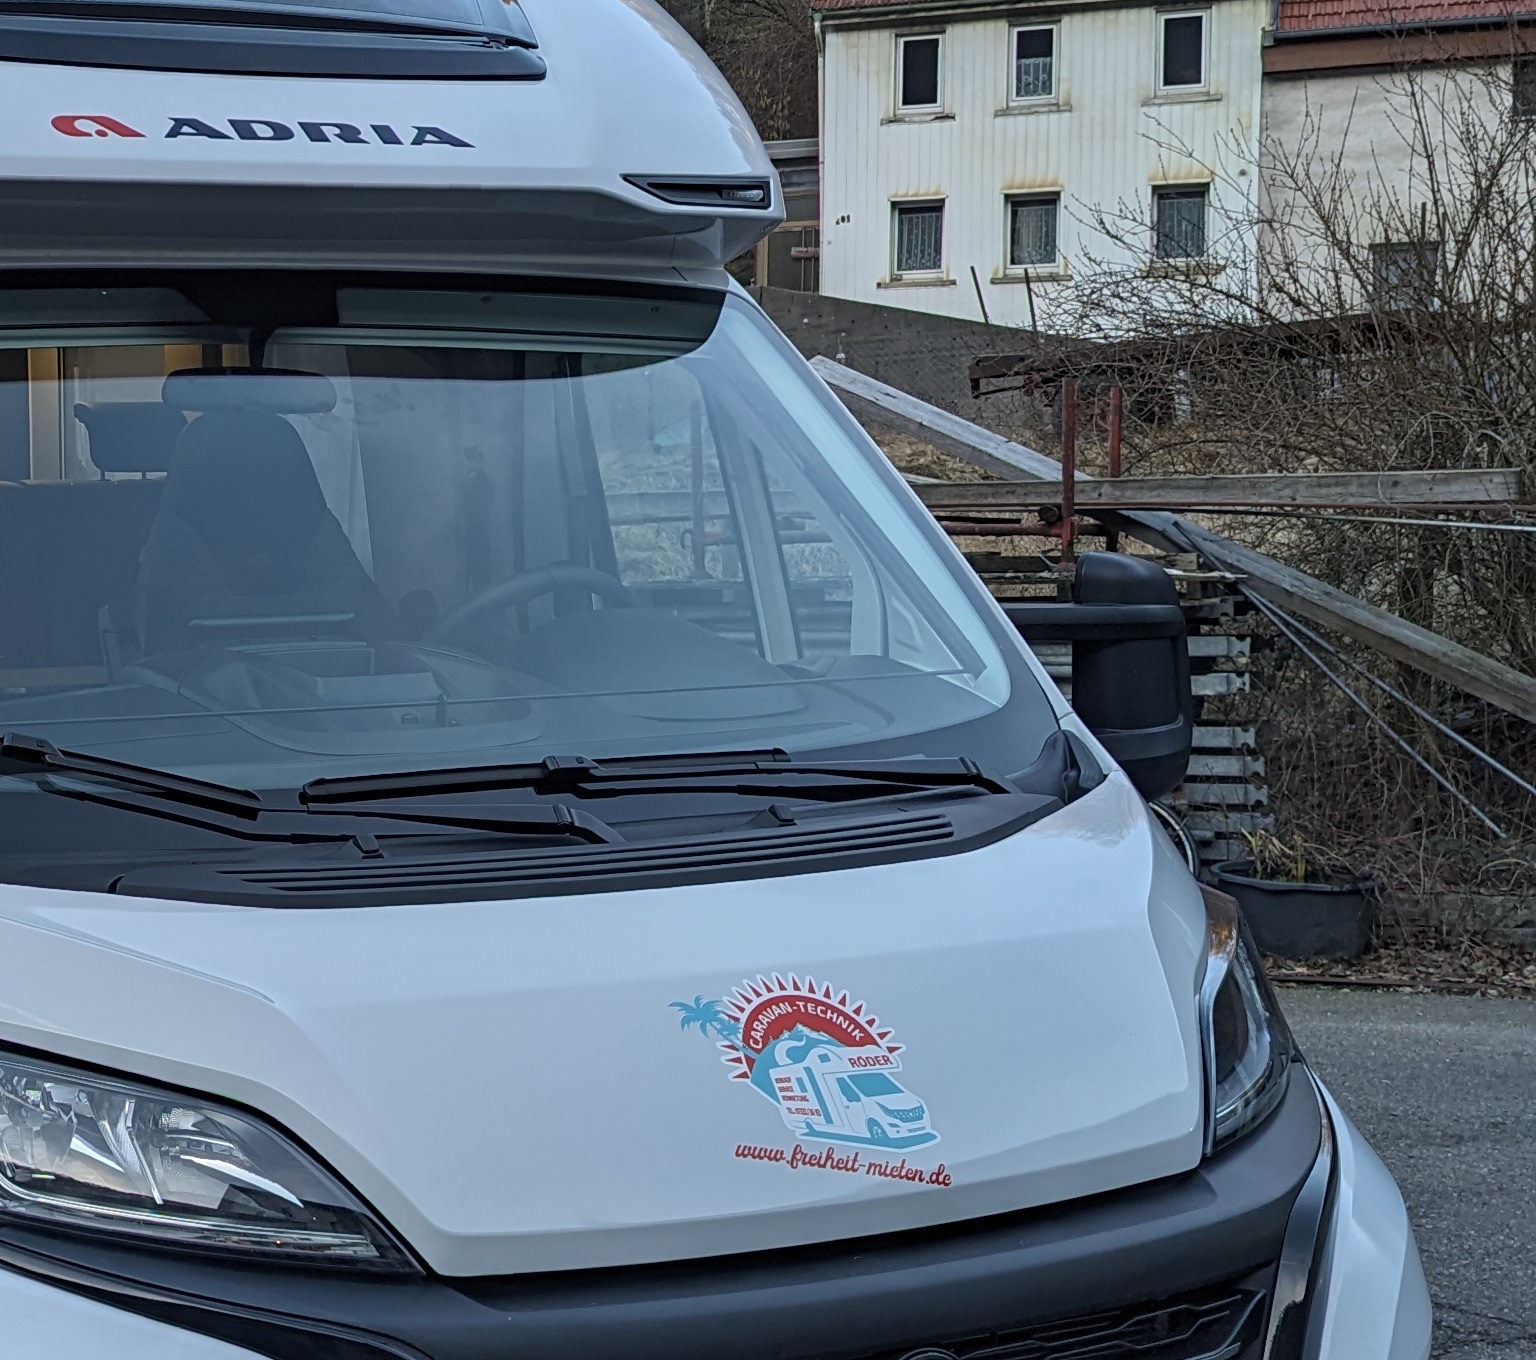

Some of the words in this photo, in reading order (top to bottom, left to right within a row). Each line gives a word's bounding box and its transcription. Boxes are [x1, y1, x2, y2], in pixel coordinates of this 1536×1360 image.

[164, 117, 476, 148] ADRIA
[749, 1000, 865, 1049] CARAVAN-TECHNIK
[848, 1055, 893, 1068] RÖDER
[734, 1144, 953, 1187] www.freiheit-mieten.de
